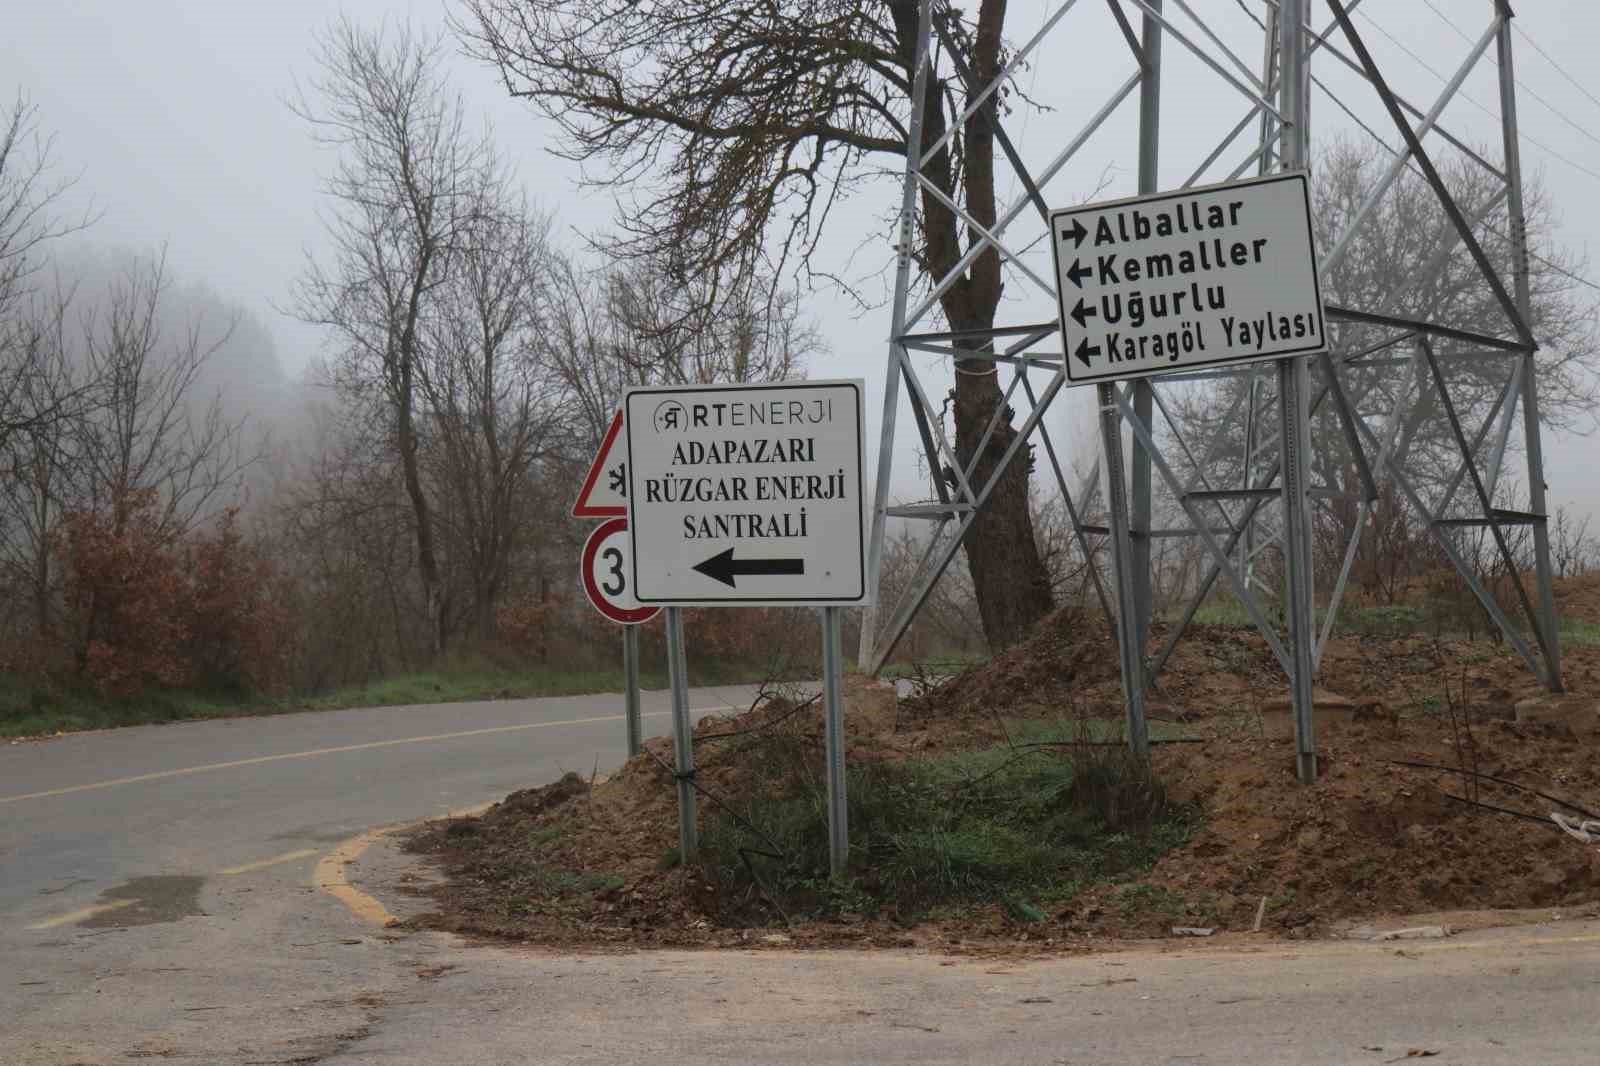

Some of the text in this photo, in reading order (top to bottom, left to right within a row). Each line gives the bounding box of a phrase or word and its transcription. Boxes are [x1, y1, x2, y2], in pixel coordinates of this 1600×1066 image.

[1094, 201, 1243, 246] Alballar
[1098, 238, 1267, 285] Kemaller
[1102, 283, 1225, 327] Uğurlu
[1106, 311, 1315, 362] Karagöl Yaylası
[671, 438, 816, 465] ADAPAZARI
[646, 468, 846, 503] RÜZGAR ENERJİ
[683, 507, 808, 538] SANTRALİ
[602, 547, 626, 596] 3
